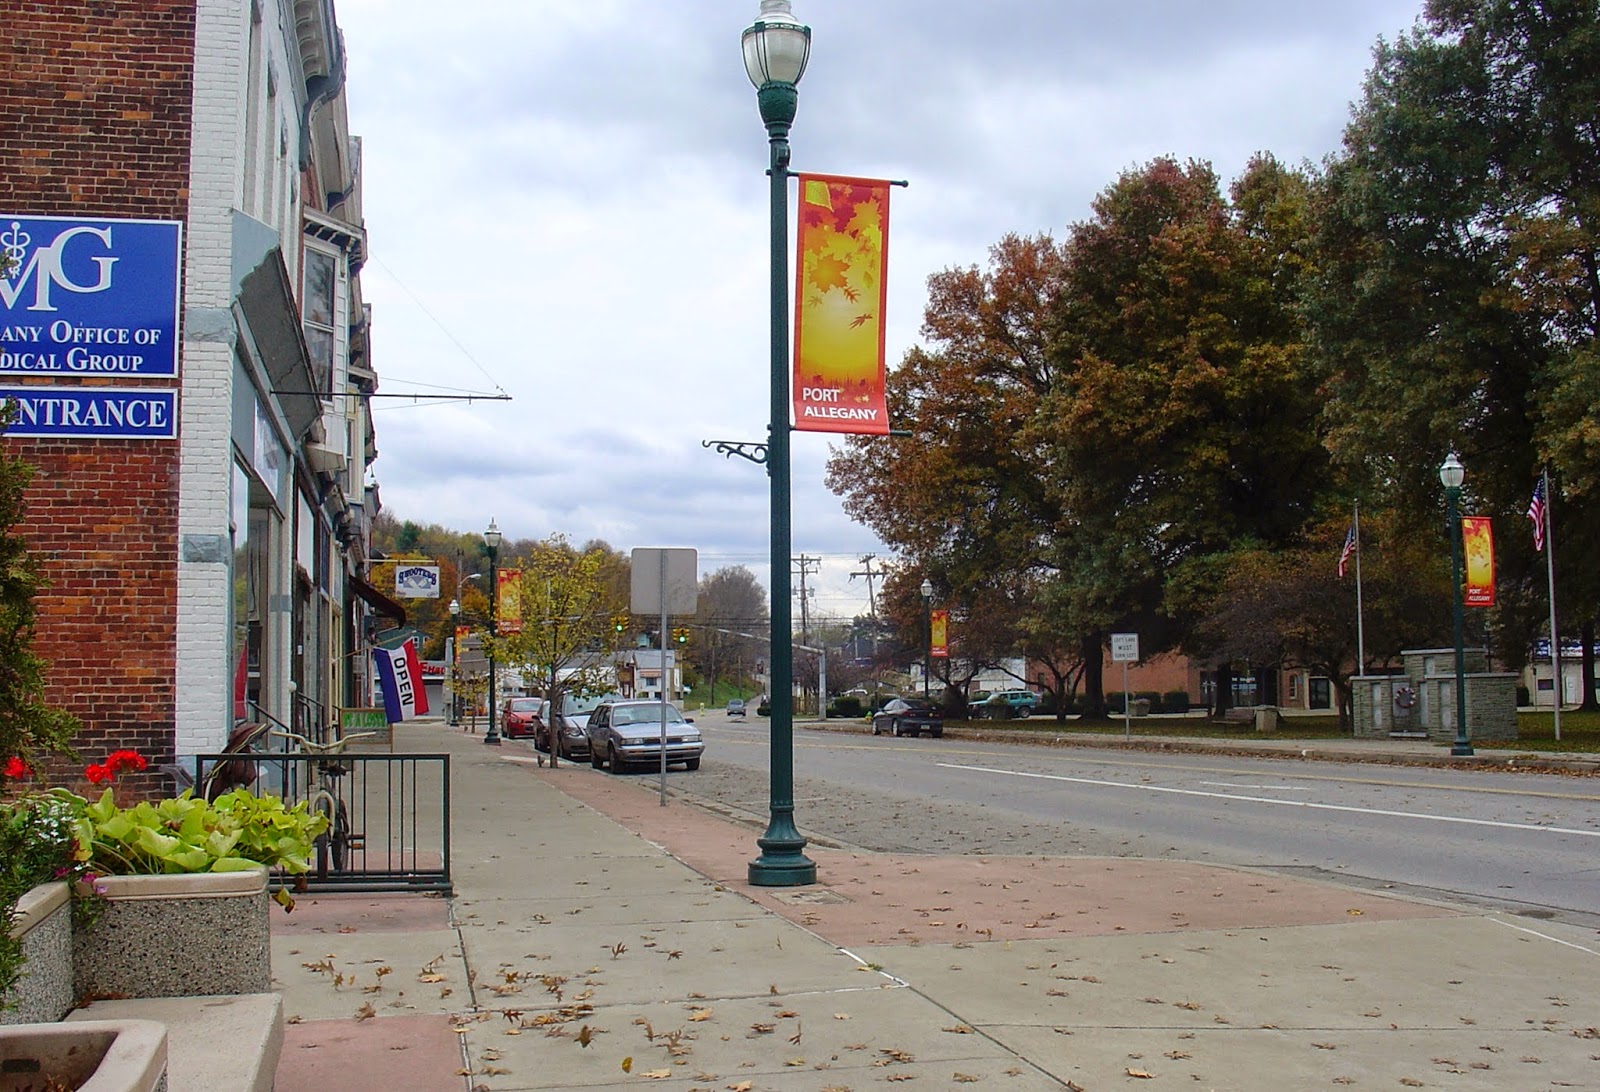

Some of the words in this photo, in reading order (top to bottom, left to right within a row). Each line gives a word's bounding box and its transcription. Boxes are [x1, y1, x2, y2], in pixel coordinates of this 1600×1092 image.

[802, 387, 840, 402] PORT
[804, 406, 877, 420] ALLEGANY
[394, 657, 414, 706] OPEN
